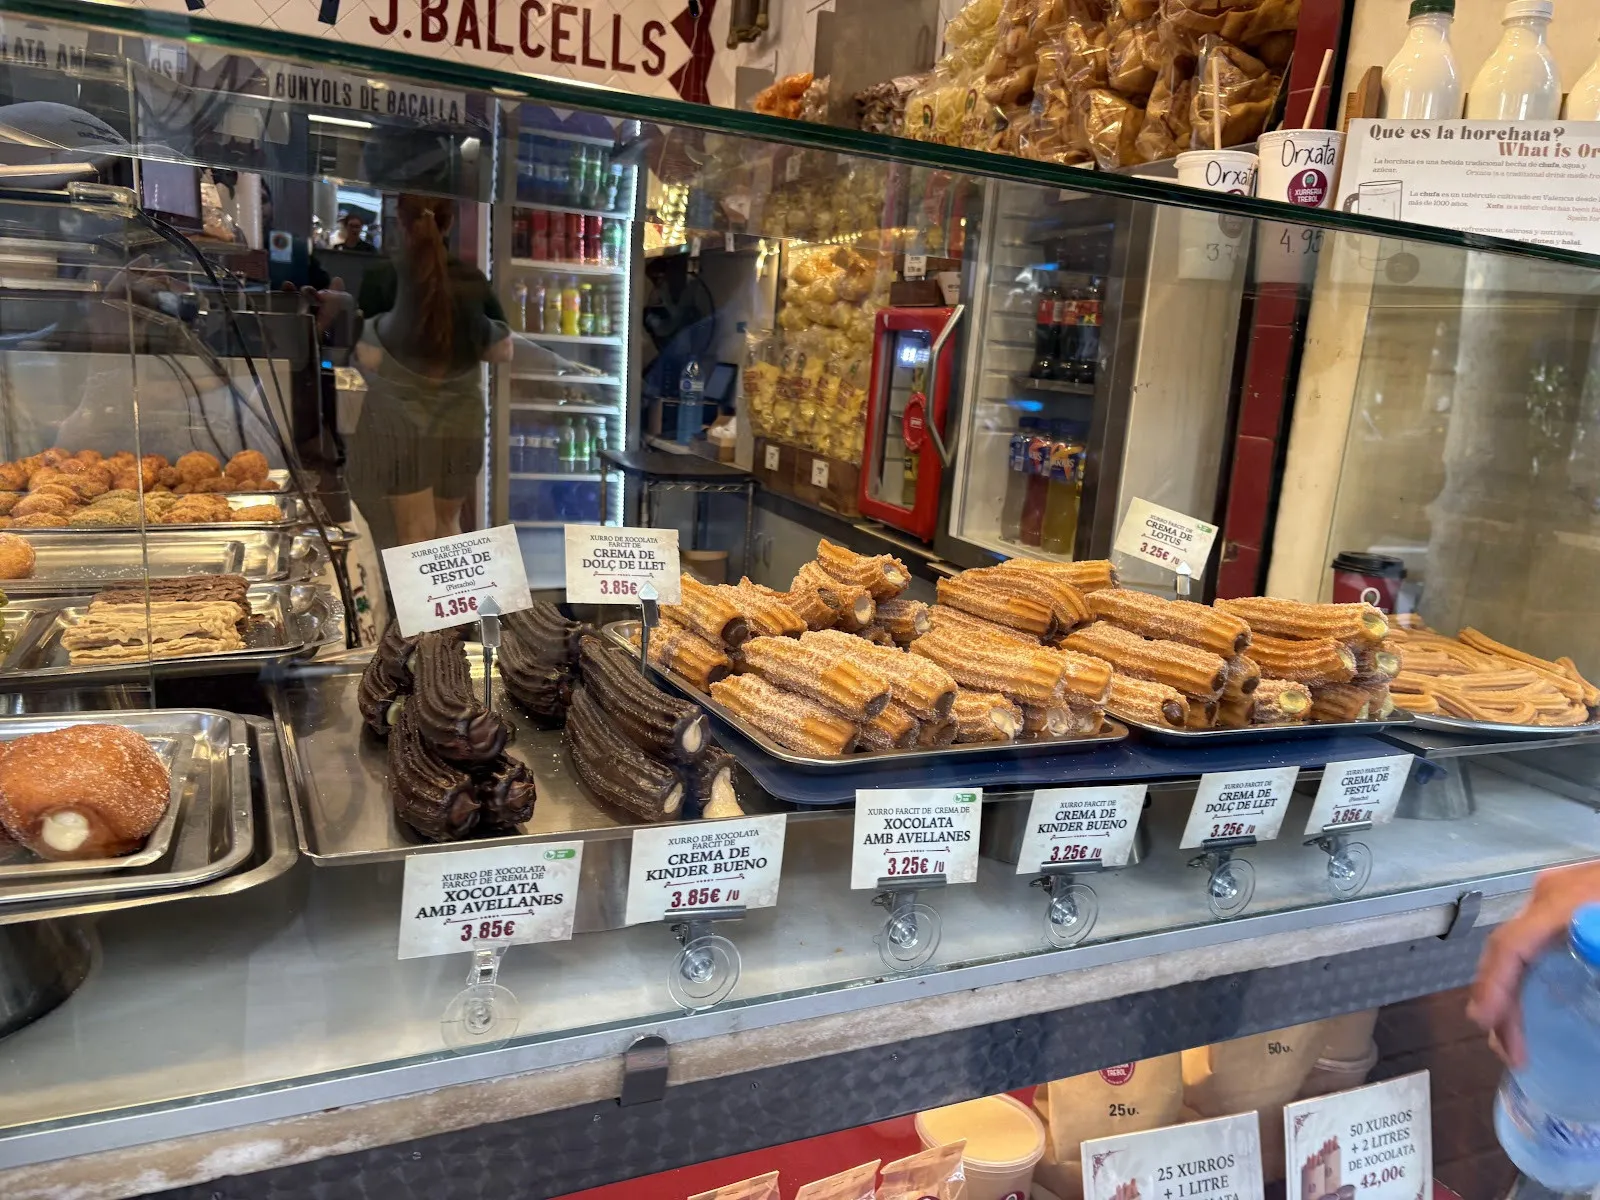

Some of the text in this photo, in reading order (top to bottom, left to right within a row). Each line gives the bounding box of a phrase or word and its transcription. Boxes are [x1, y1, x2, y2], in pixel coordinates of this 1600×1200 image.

[275, 72, 459, 125] BUNYOLS DE BACALLA
[1369, 124, 1565, 142] Qué es la horchata?
[1281, 137, 1336, 167] Orxata
[1499, 142, 1549, 157] What
[1554, 143, 1571, 158] is
[1145, 519, 1193, 541] CREMA DE
[1151, 529, 1181, 546] LOTUS
[411, 537, 491, 558] XURRO DE XOCOLATA
[434, 549, 460, 560] FARCIT
[593, 548, 655, 559] CREMA DE
[1140, 542, 1170, 560] 3.25€
[419, 551, 491, 575] CREMA DE
[582, 558, 666, 571] DOLÇ DE LLET
[431, 565, 485, 585] FESTUC
[446, 580, 476, 591] (Pistacho)
[600, 580, 637, 595] 3.85€
[435, 596, 478, 618] 4.35€
[1341, 772, 1390, 787] CREMA DE
[1218, 788, 1272, 802] CREMA DE
[1343, 784, 1380, 796] FESTUC
[867, 808, 894, 816] XURRO
[895, 807, 920, 815] FARCIT
[1205, 798, 1278, 813] DOLÇ DE LLET
[1055, 808, 1117, 821] CREMA DE
[1332, 808, 1363, 824] 3.85€
[883, 817, 954, 830] XOCOLATA
[1037, 819, 1127, 834] KINDER BUENO
[1210, 822, 1244, 838] 3.25€
[667, 829, 759, 846] XURRO DE XOCOLATA
[692, 838, 736, 850] FARCIT DE
[863, 830, 971, 845] AMB AVELLANES
[667, 846, 750, 866] CREMA DE
[1050, 844, 1088, 861] 3.25€
[441, 865, 546, 882] XURRO DE XOCOLATA
[646, 857, 768, 881] KINDER BUENO
[887, 856, 945, 876] 3.25€ /U
[442, 872, 544, 889] FARCIT DE CREMA DE
[443, 882, 540, 902] XOCOLATA
[671, 887, 740, 908] 3.85€ /U
[414, 893, 564, 919] AMB AVELLANES
[460, 920, 516, 942] 3.85€
[1106, 1068, 1127, 1077] TREBOL
[1349, 1109, 1412, 1137] 50 XURROS
[1362, 1139, 1369, 1152] 2
[1371, 1127, 1410, 1149] LITRES
[1348, 1144, 1416, 1171] DE XOCOLATA
[1157, 1154, 1235, 1181] 25 XURROS
[1360, 1165, 1406, 1188] 42,00€
[1178, 1184, 1185, 1198] 1
[1189, 1175, 1229, 1195] LITRE
